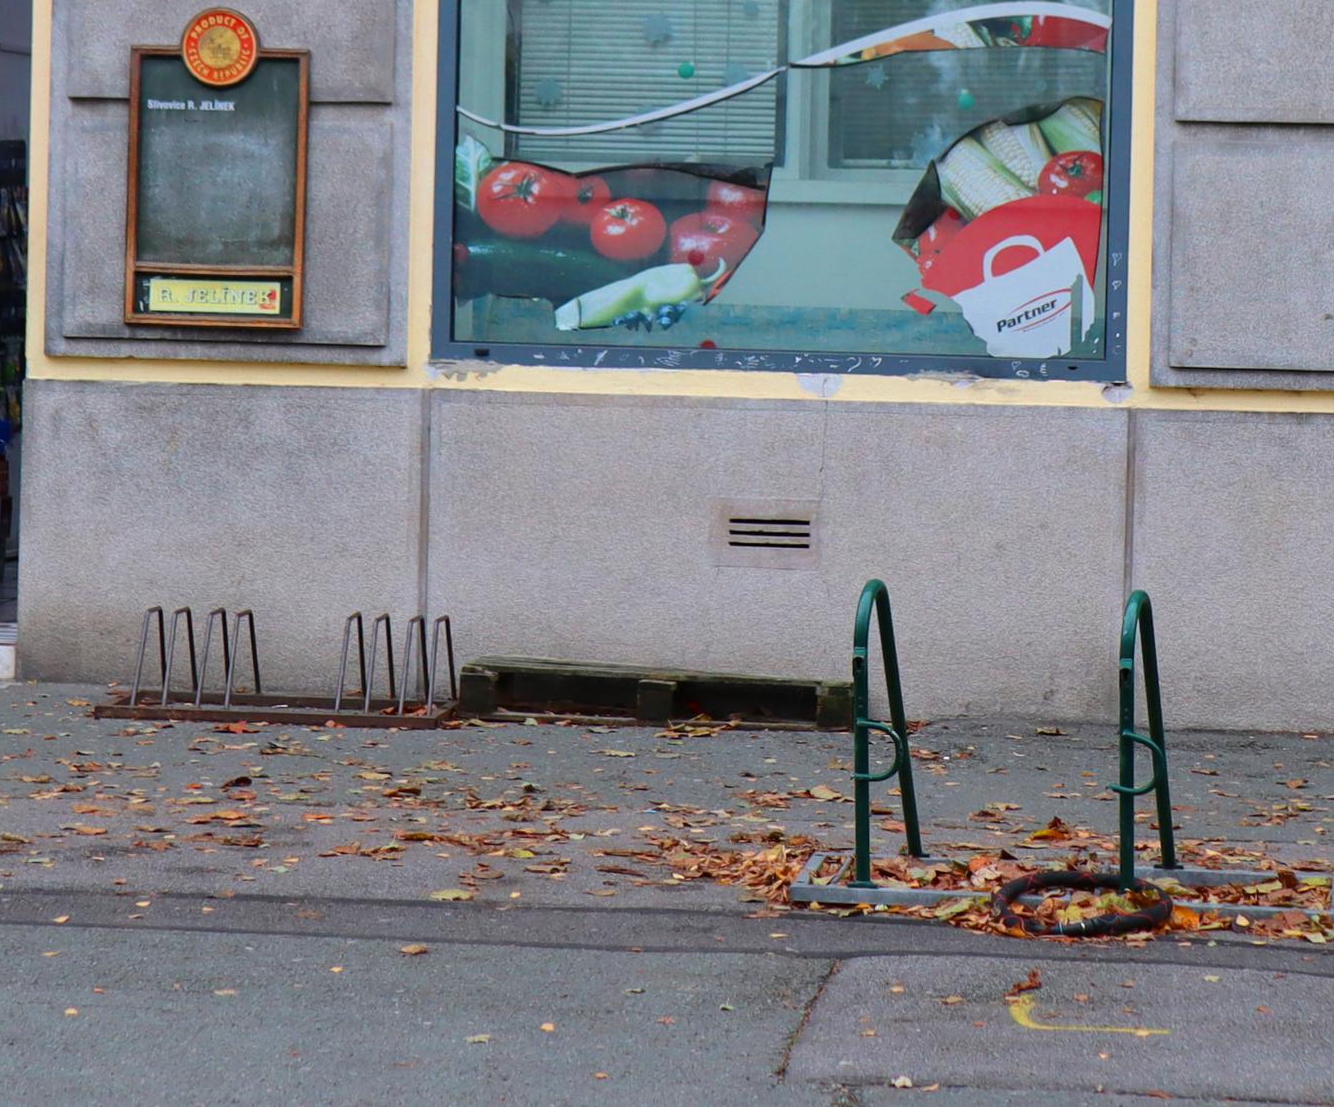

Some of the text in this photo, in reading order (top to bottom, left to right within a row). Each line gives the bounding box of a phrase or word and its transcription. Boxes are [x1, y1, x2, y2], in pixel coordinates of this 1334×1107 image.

[190, 14, 250, 41] PRODUCT OF
[995, 298, 1059, 334] Partner
